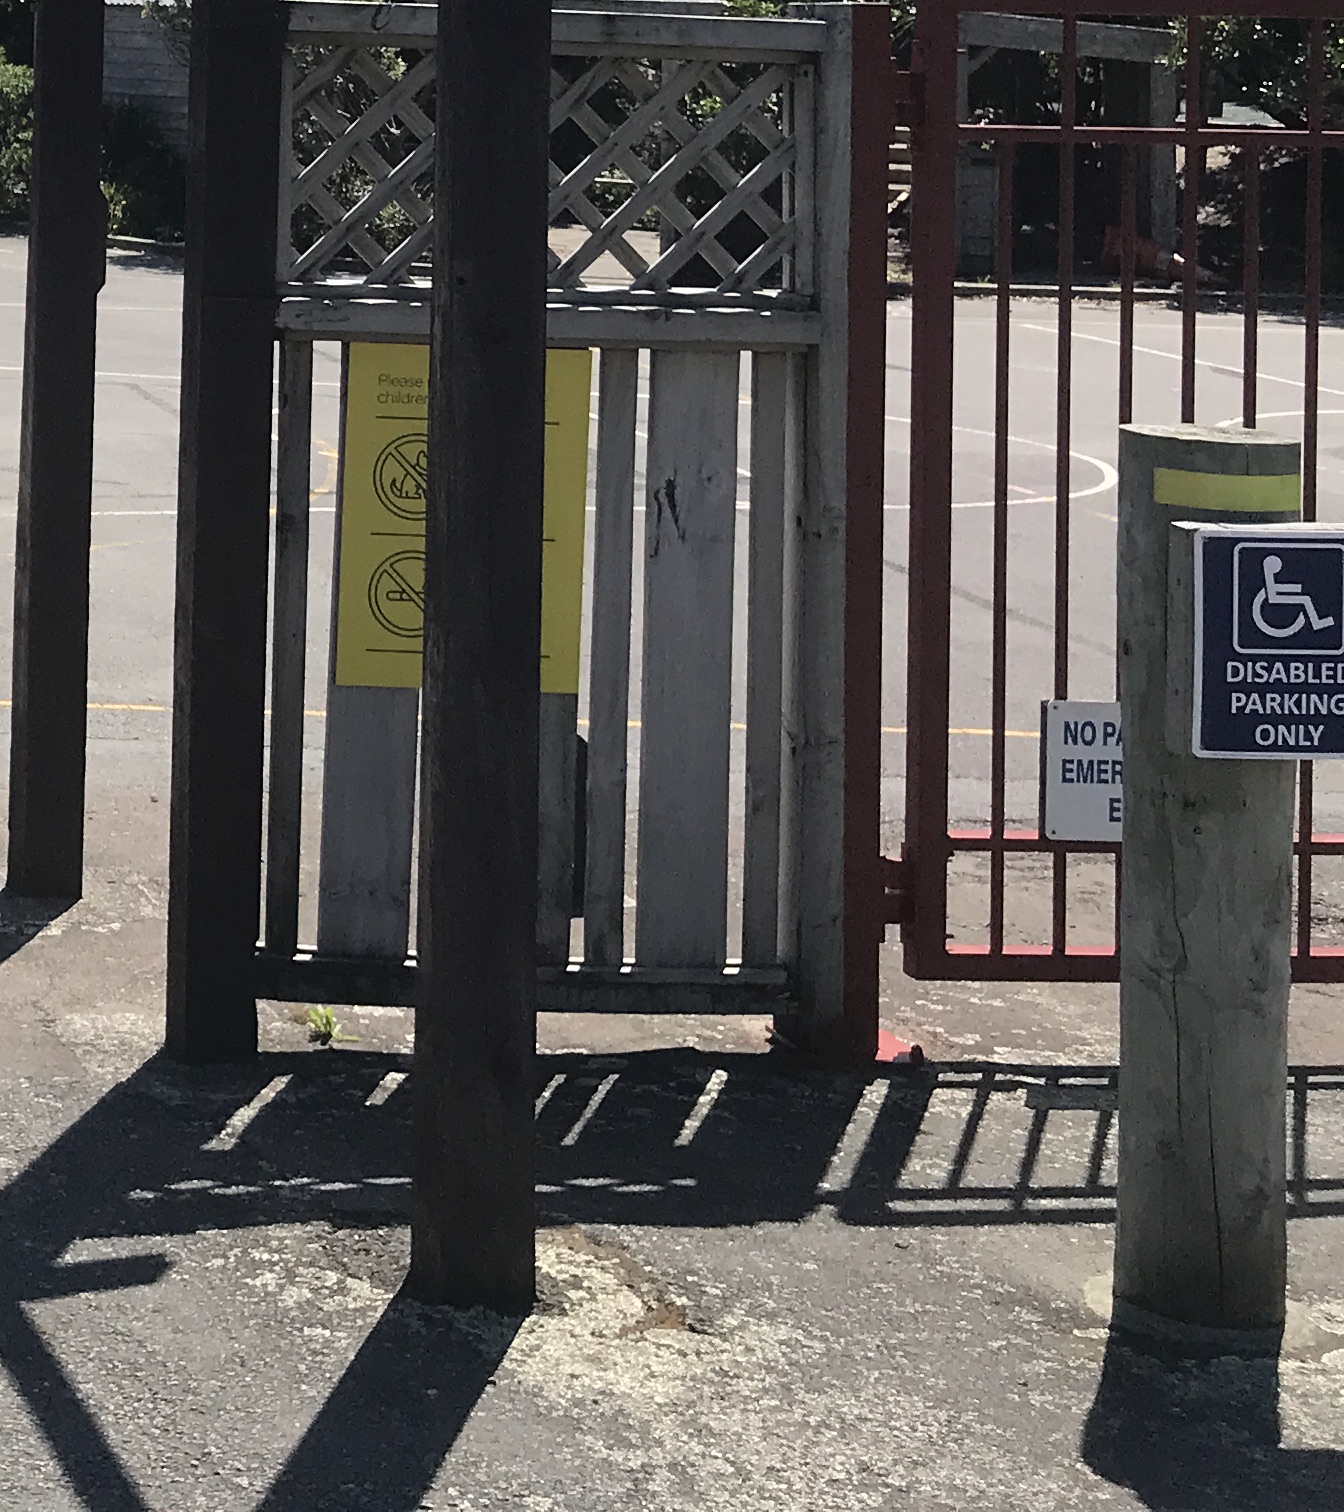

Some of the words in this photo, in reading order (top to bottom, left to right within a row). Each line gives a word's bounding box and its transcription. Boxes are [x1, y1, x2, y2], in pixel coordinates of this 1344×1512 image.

[378, 373, 424, 388] Please
[1231, 692, 1344, 716] PARKING
[1063, 720, 1097, 746] NO
[1255, 723, 1325, 746] ONLY
